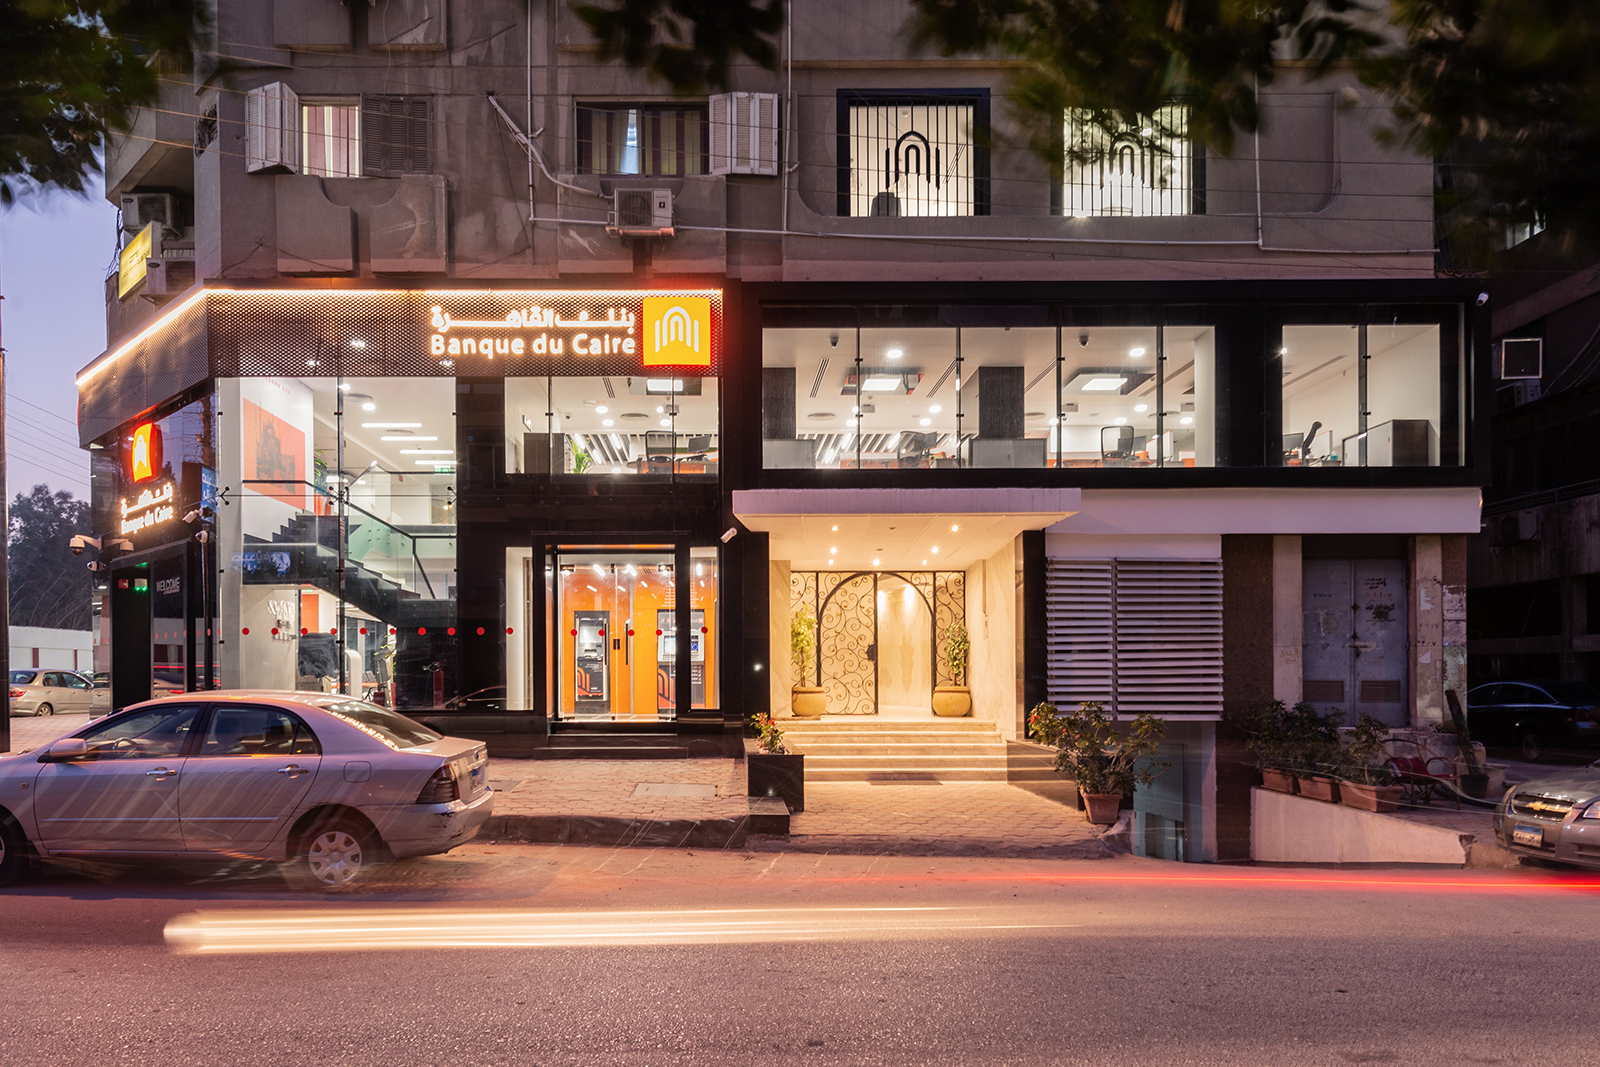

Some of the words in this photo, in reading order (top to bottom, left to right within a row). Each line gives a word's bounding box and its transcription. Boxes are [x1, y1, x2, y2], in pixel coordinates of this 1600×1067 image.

[431, 306, 554, 332] القاهرة
[555, 308, 635, 334] بنك
[431, 334, 524, 359] Banque
[533, 333, 562, 354] du
[573, 333, 635, 354] Caire
[155, 577, 180, 592] WELCOME
